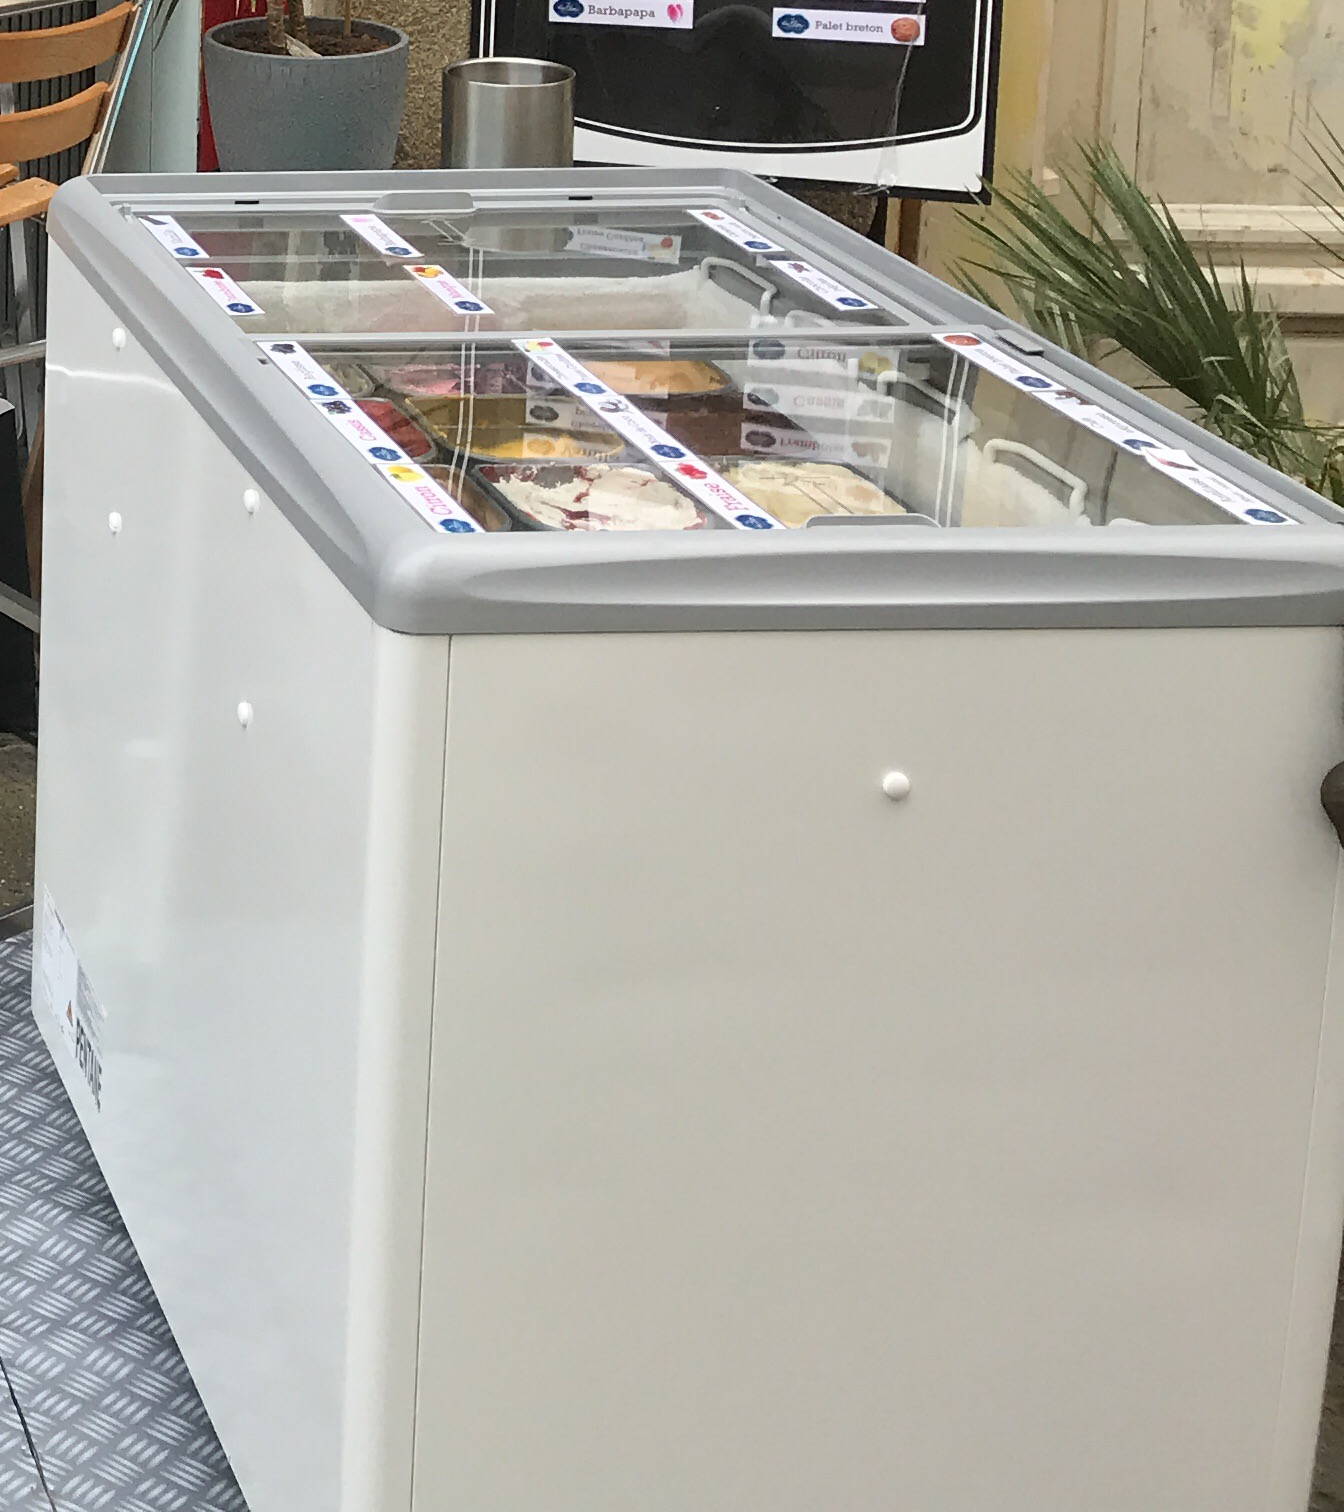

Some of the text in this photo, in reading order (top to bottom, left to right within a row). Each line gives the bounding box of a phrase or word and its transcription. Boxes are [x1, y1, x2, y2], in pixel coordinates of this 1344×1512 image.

[588, 4, 656, 20] Barbapapa
[814, 20, 884, 33] Palet breton
